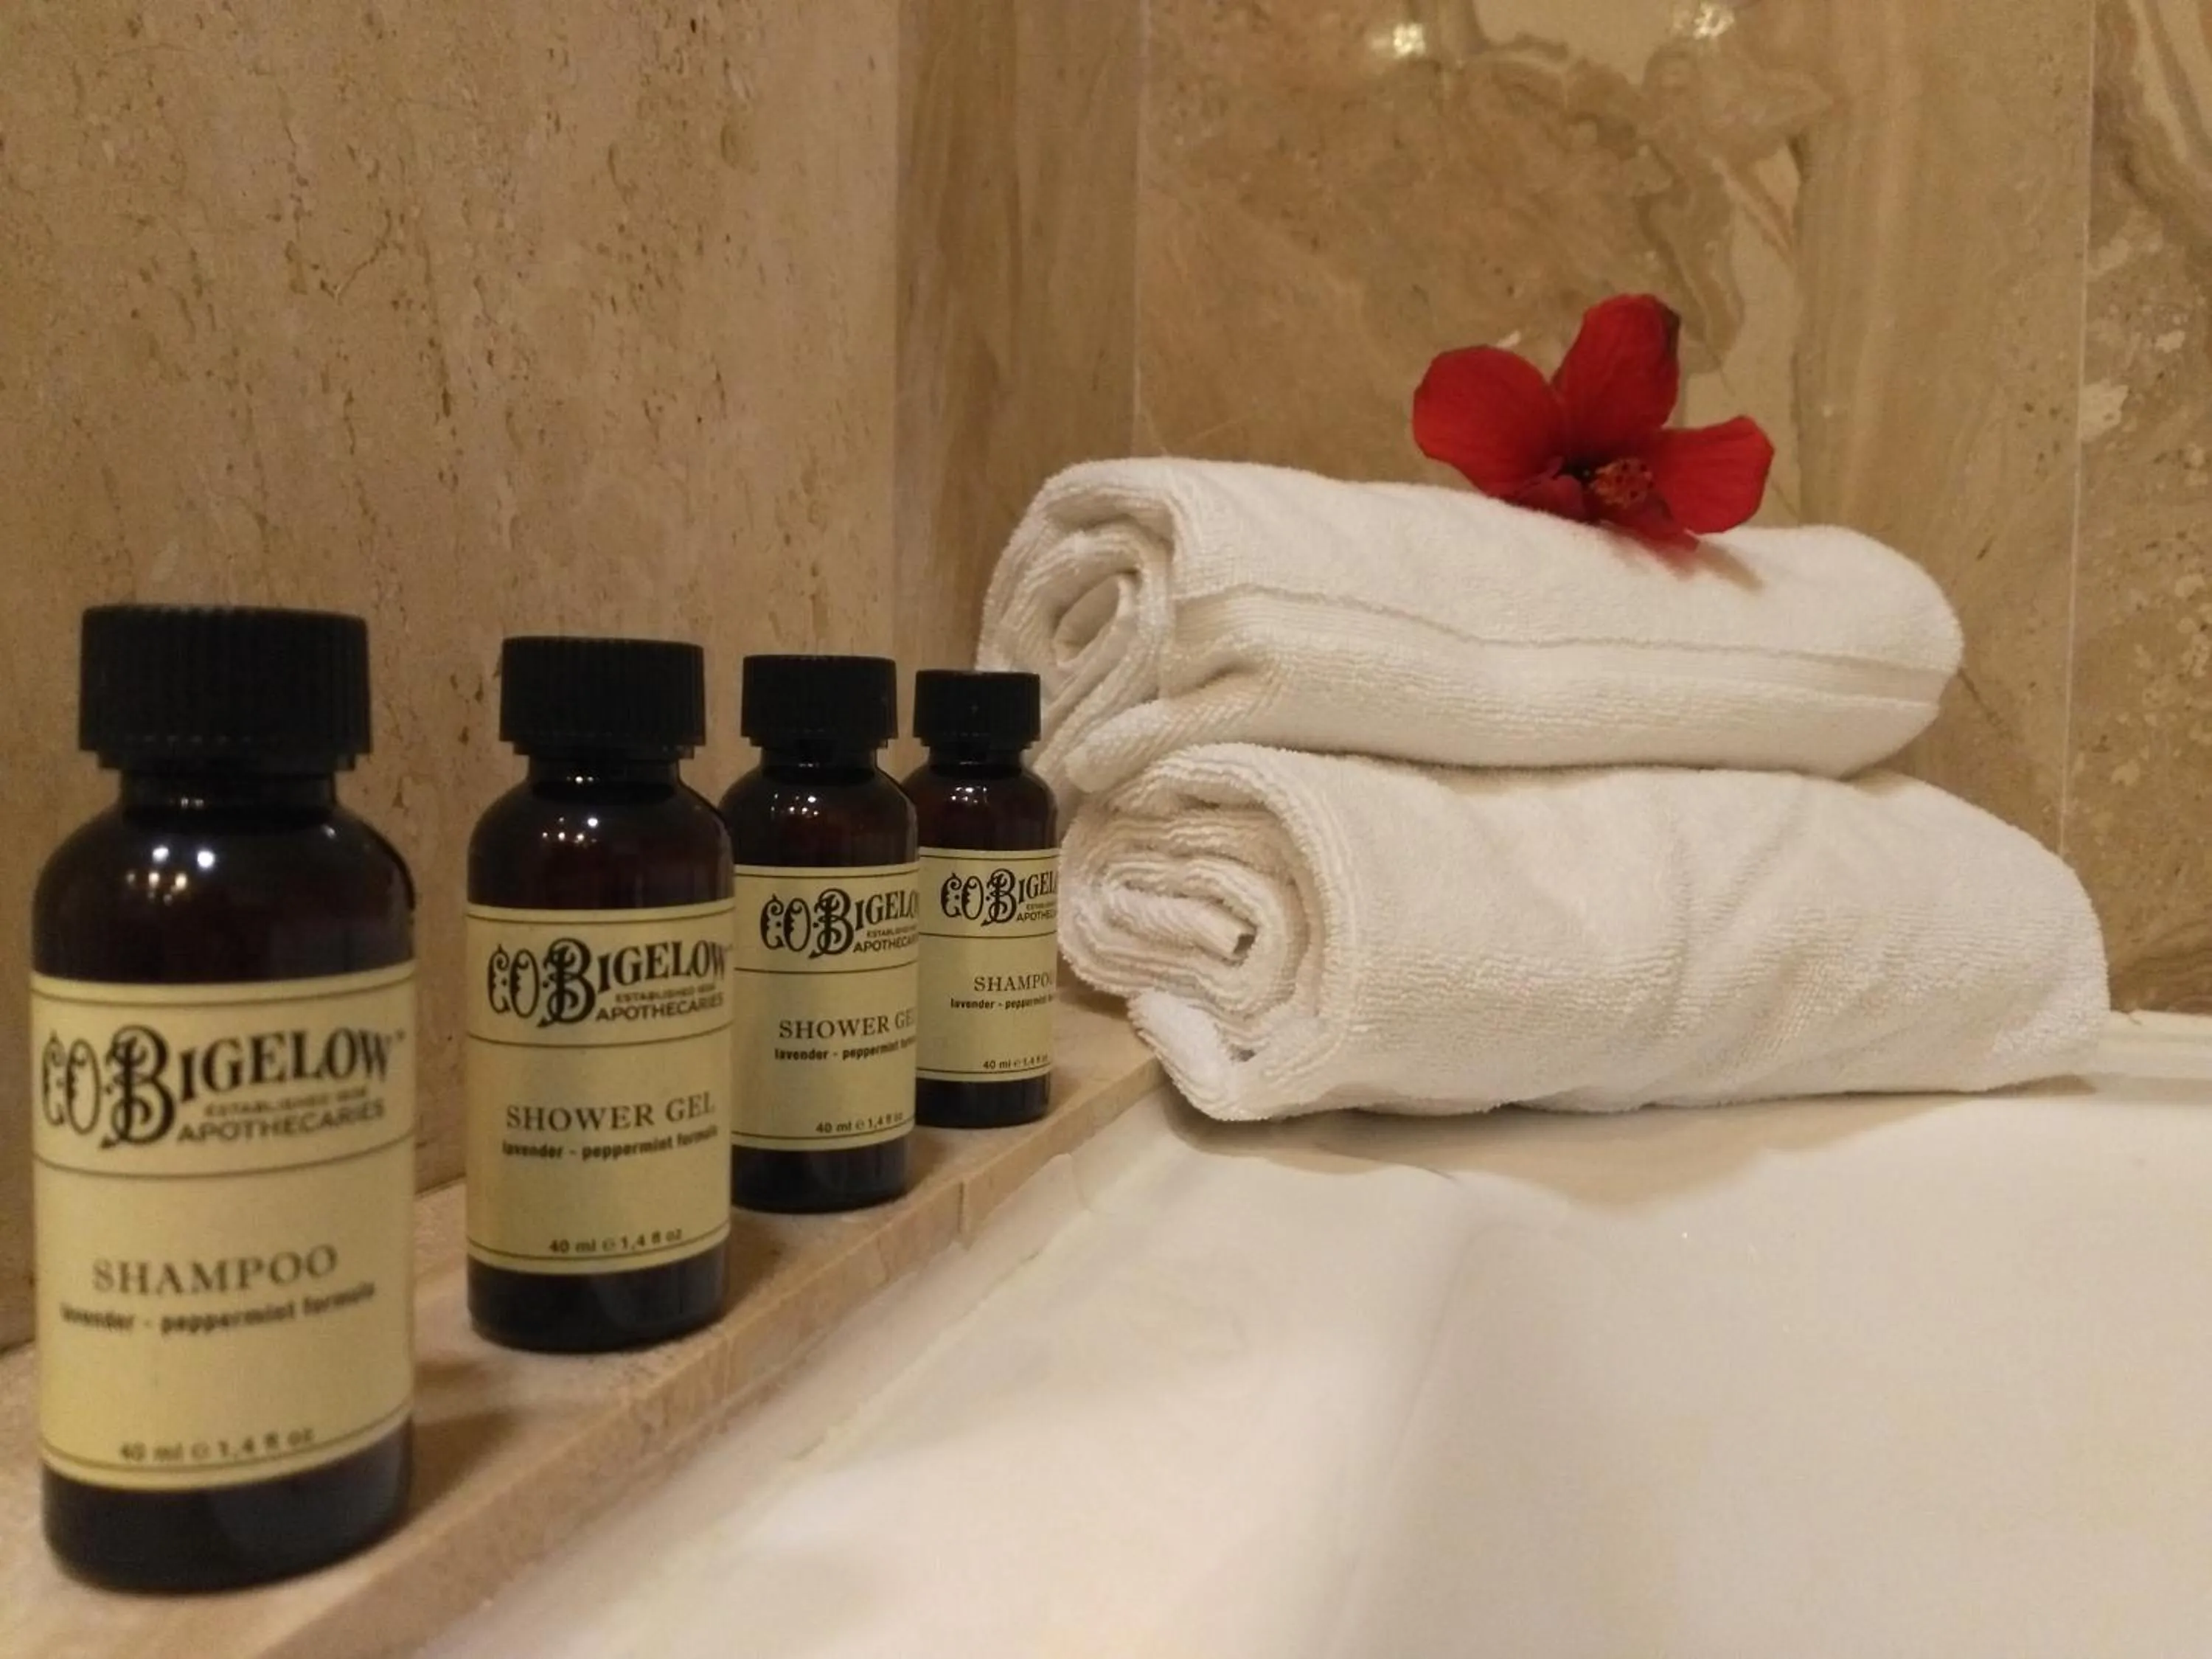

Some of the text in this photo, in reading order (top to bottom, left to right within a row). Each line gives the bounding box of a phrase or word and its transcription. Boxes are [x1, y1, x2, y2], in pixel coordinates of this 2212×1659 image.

[980, 868, 1057, 927] BIGEL
[809, 888, 919, 959] BIGELO
[595, 992, 724, 1022] APOTHECARIES
[950, 998, 995, 1009] lavender
[1005, 995, 1047, 1009] peppermint
[779, 1008, 917, 1040] SHOWER GE
[774, 1048, 830, 1061] lavender
[843, 1040, 899, 1061] peppermint
[982, 1060, 996, 1069] 40
[999, 1059, 1011, 1068] ml
[178, 1099, 385, 1142] APOTHECARIES
[506, 1092, 717, 1133] SHOWER GEL
[815, 1122, 832, 1133] 40
[836, 1121, 852, 1133] ml
[502, 1139, 564, 1159] lavender
[581, 1135, 672, 1162] peppermint
[549, 1239, 570, 1253] 40
[575, 1239, 596, 1252] ml
[92, 1244, 338, 1295] SHAMPOO
[160, 1299, 294, 1336] peppermint
[153, 1441, 183, 1461] ml
